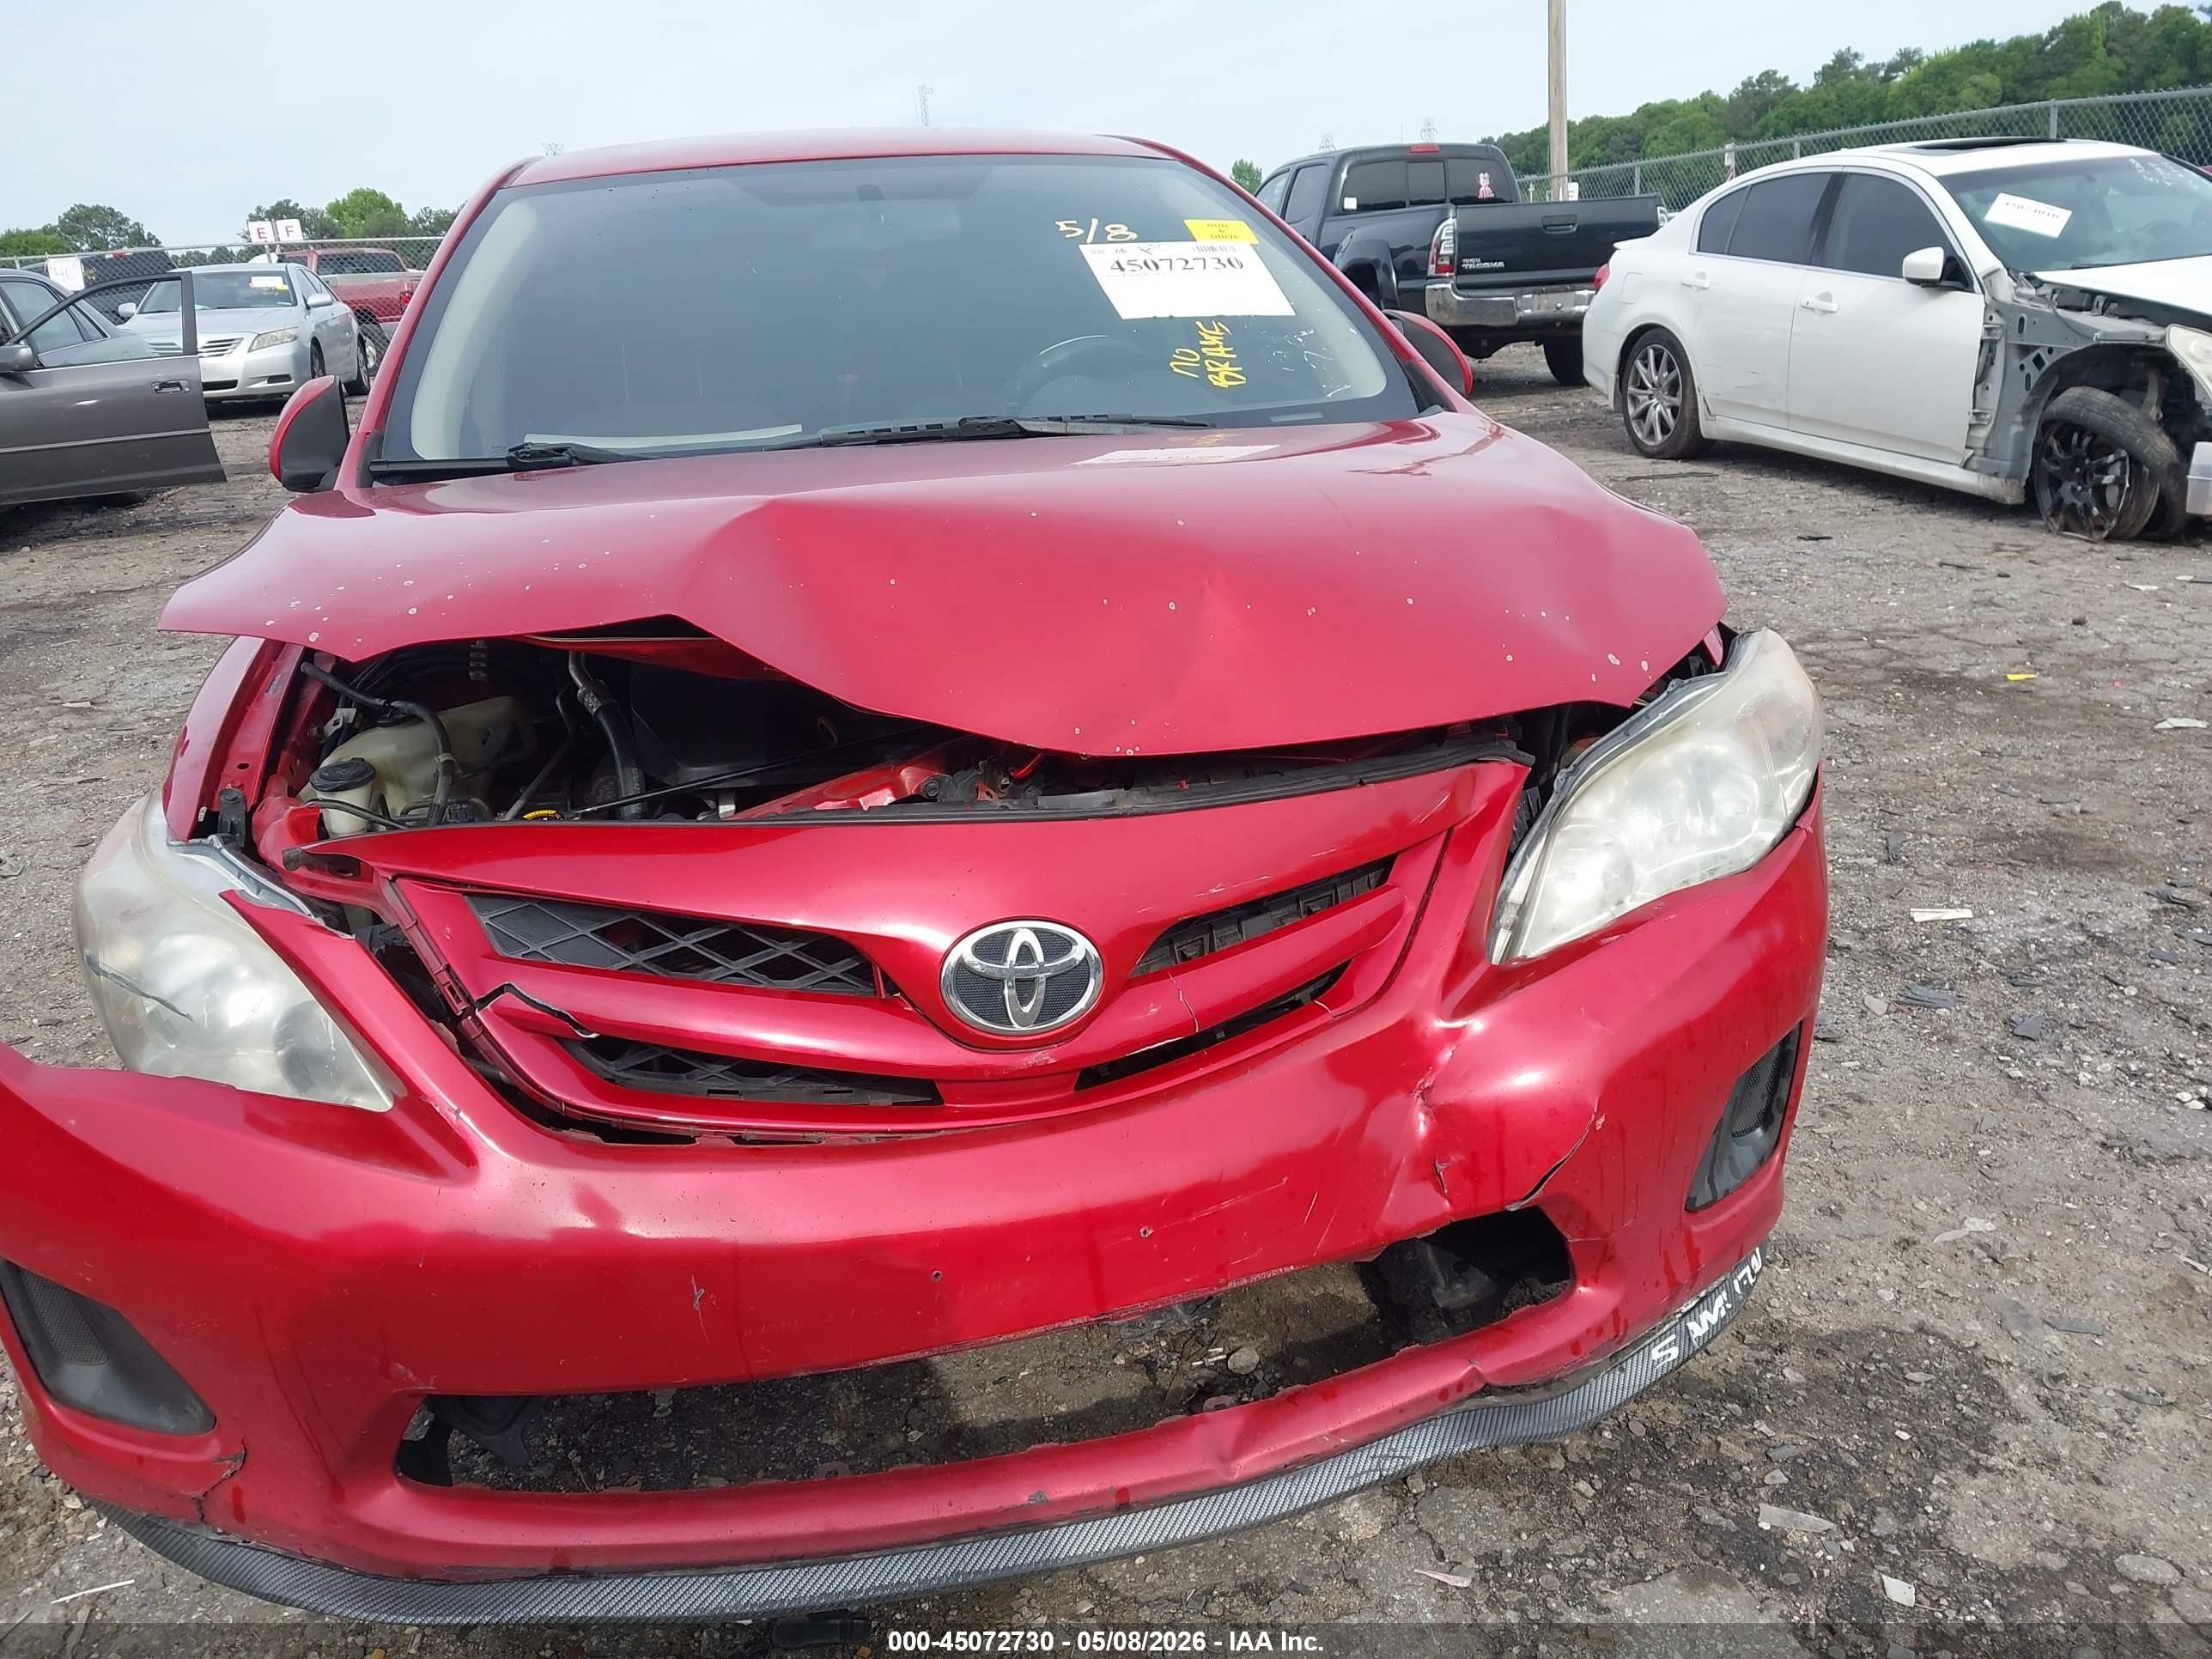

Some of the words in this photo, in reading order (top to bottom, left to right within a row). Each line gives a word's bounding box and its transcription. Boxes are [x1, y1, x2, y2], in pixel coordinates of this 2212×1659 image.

[256, 227, 268, 240] E
[284, 225, 295, 238] F
[1054, 217, 1139, 244] 5/8
[1109, 256, 1244, 273] 45072730
[1461, 260, 1505, 270] TACOMA
